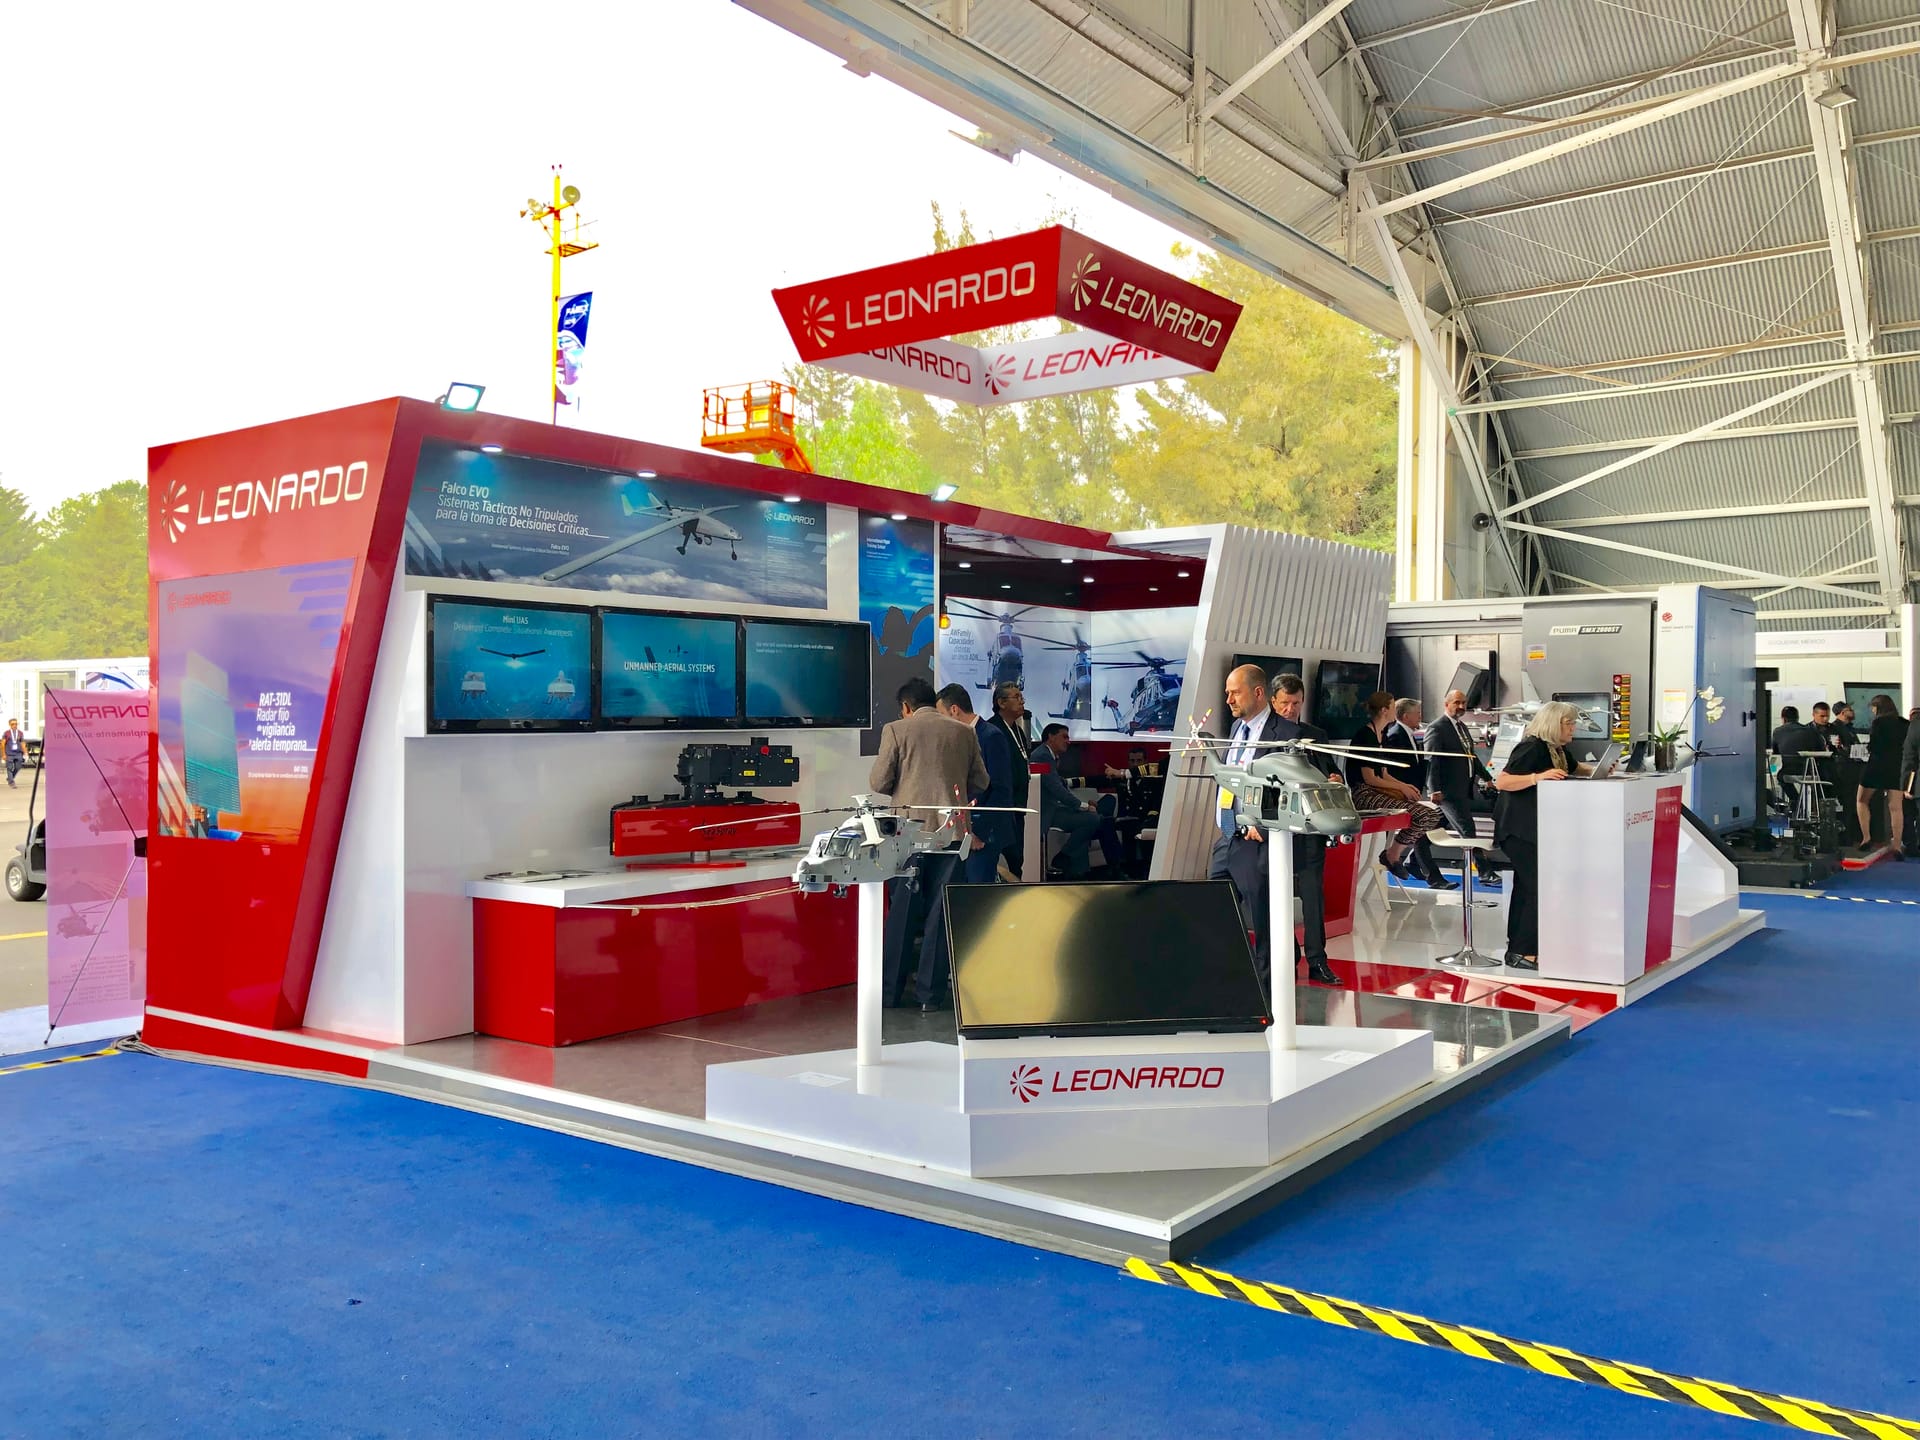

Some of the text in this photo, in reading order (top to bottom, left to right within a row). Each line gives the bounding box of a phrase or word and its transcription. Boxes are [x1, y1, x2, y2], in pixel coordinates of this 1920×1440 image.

[845, 261, 1036, 330] LEONARDO
[1100, 276, 1223, 349] LEONARDO
[197, 461, 368, 525] LEONARDO
[441, 481, 489, 499] Falco EVO
[438, 494, 480, 511] Sistemas
[519, 505, 532, 518] No
[535, 507, 579, 524] Tripulados
[436, 508, 457, 521] para
[460, 509, 468, 522] la
[470, 513, 494, 525] toma
[496, 514, 508, 527] de
[510, 516, 556, 533] Decisiones
[773, 512, 816, 526] LEONARDO
[516, 616, 529, 625] UAS
[623, 661, 715, 673] UNMANNED AERIAL SYSTEMS
[259, 692, 292, 707] RAT-31DL
[256, 707, 290, 723] Radar fijo
[262, 722, 296, 738] vigilancia
[251, 737, 272, 751] alerta
[272, 738, 307, 754] temprana
[1052, 1067, 1225, 1092] LEONARDO
